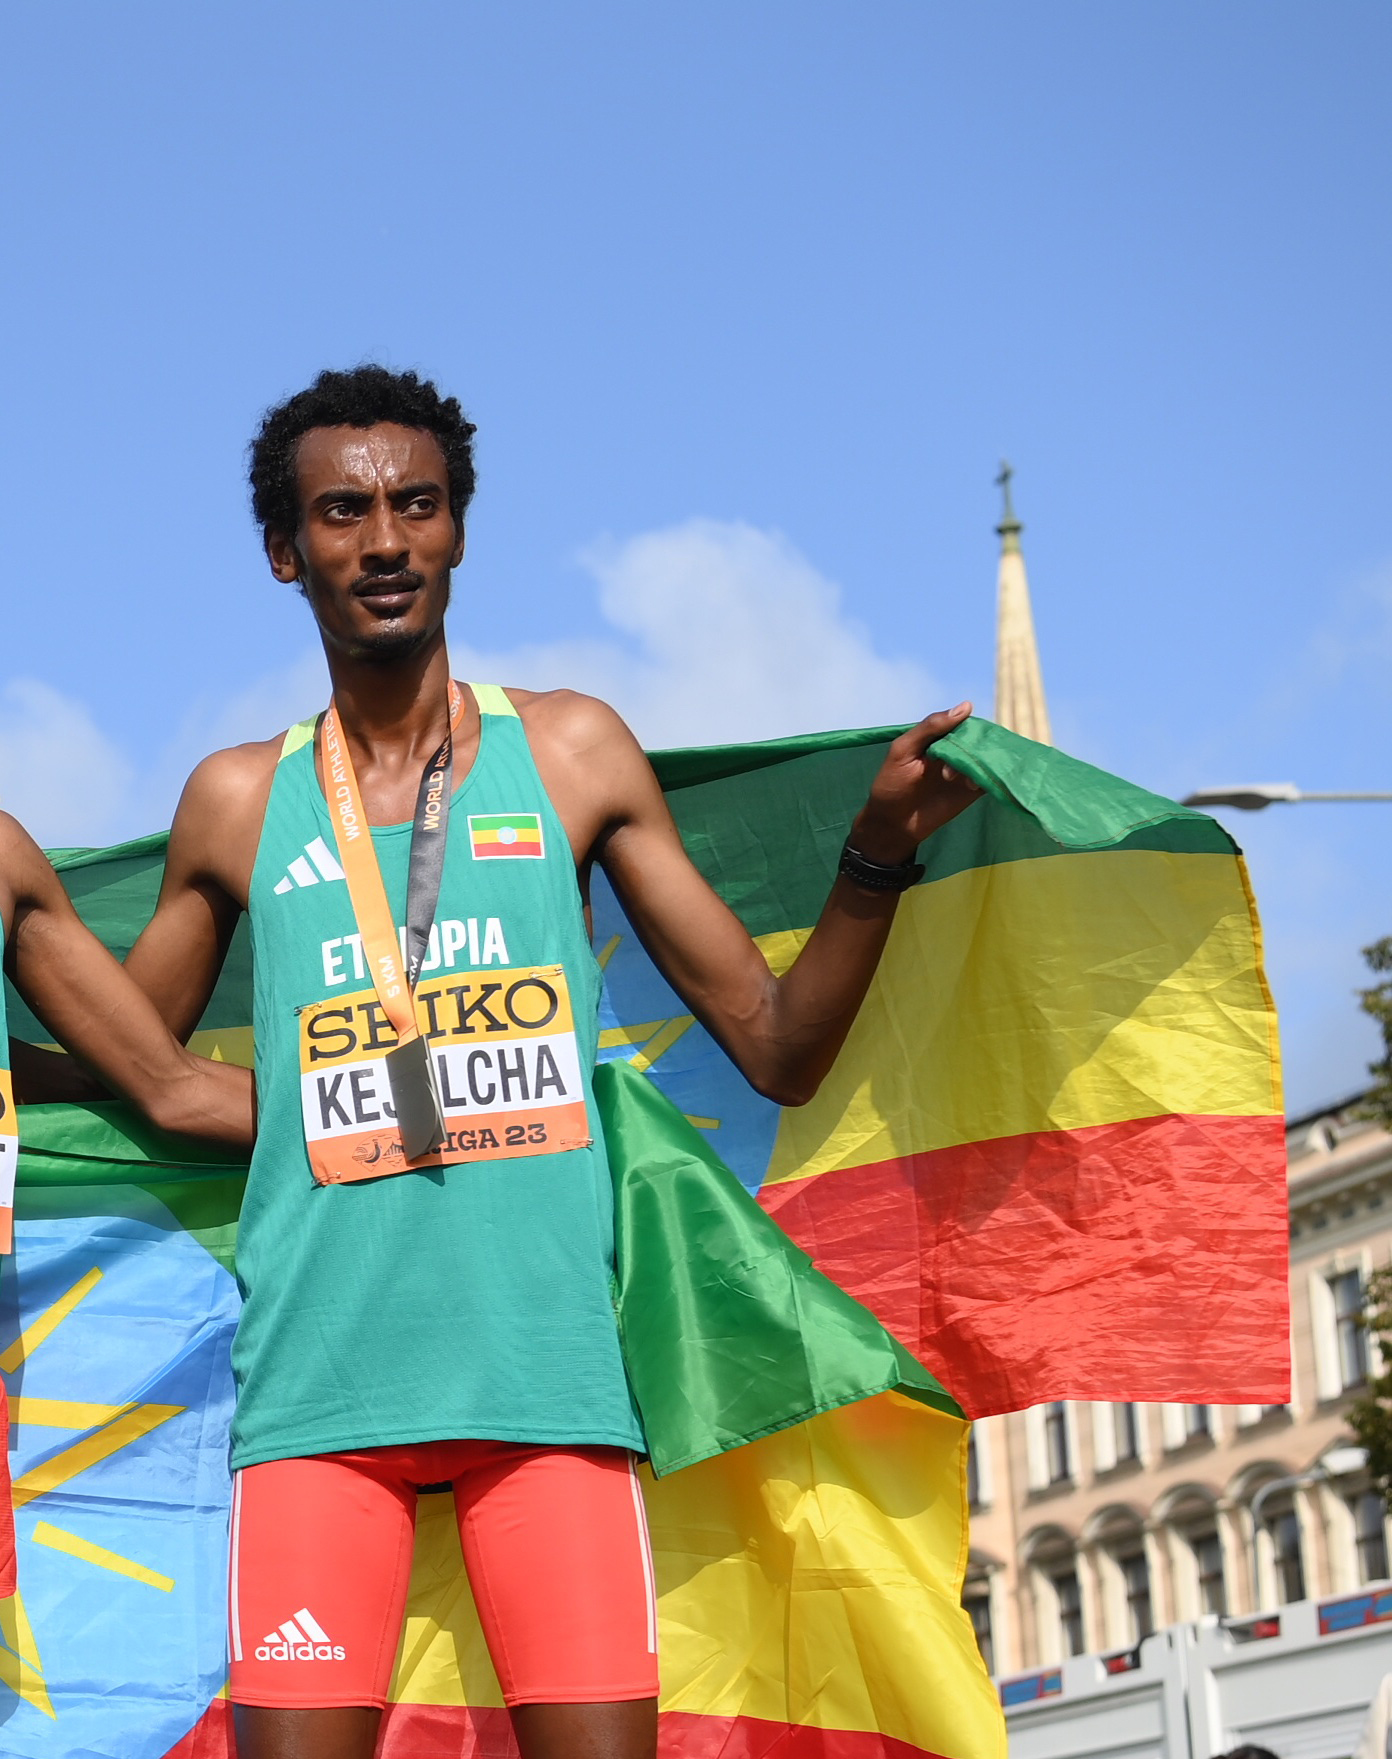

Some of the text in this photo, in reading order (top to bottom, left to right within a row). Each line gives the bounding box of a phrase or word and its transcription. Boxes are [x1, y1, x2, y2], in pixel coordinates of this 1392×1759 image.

[336, 786, 361, 843] WORLD
[423, 770, 445, 831] WORLD
[378, 955, 401, 999] 5 KM
[307, 978, 559, 1063] SEIKO
[316, 1044, 568, 1130] KELCHA
[425, 1123, 548, 1156] IGA 23
[254, 1641, 346, 1661] adidas
